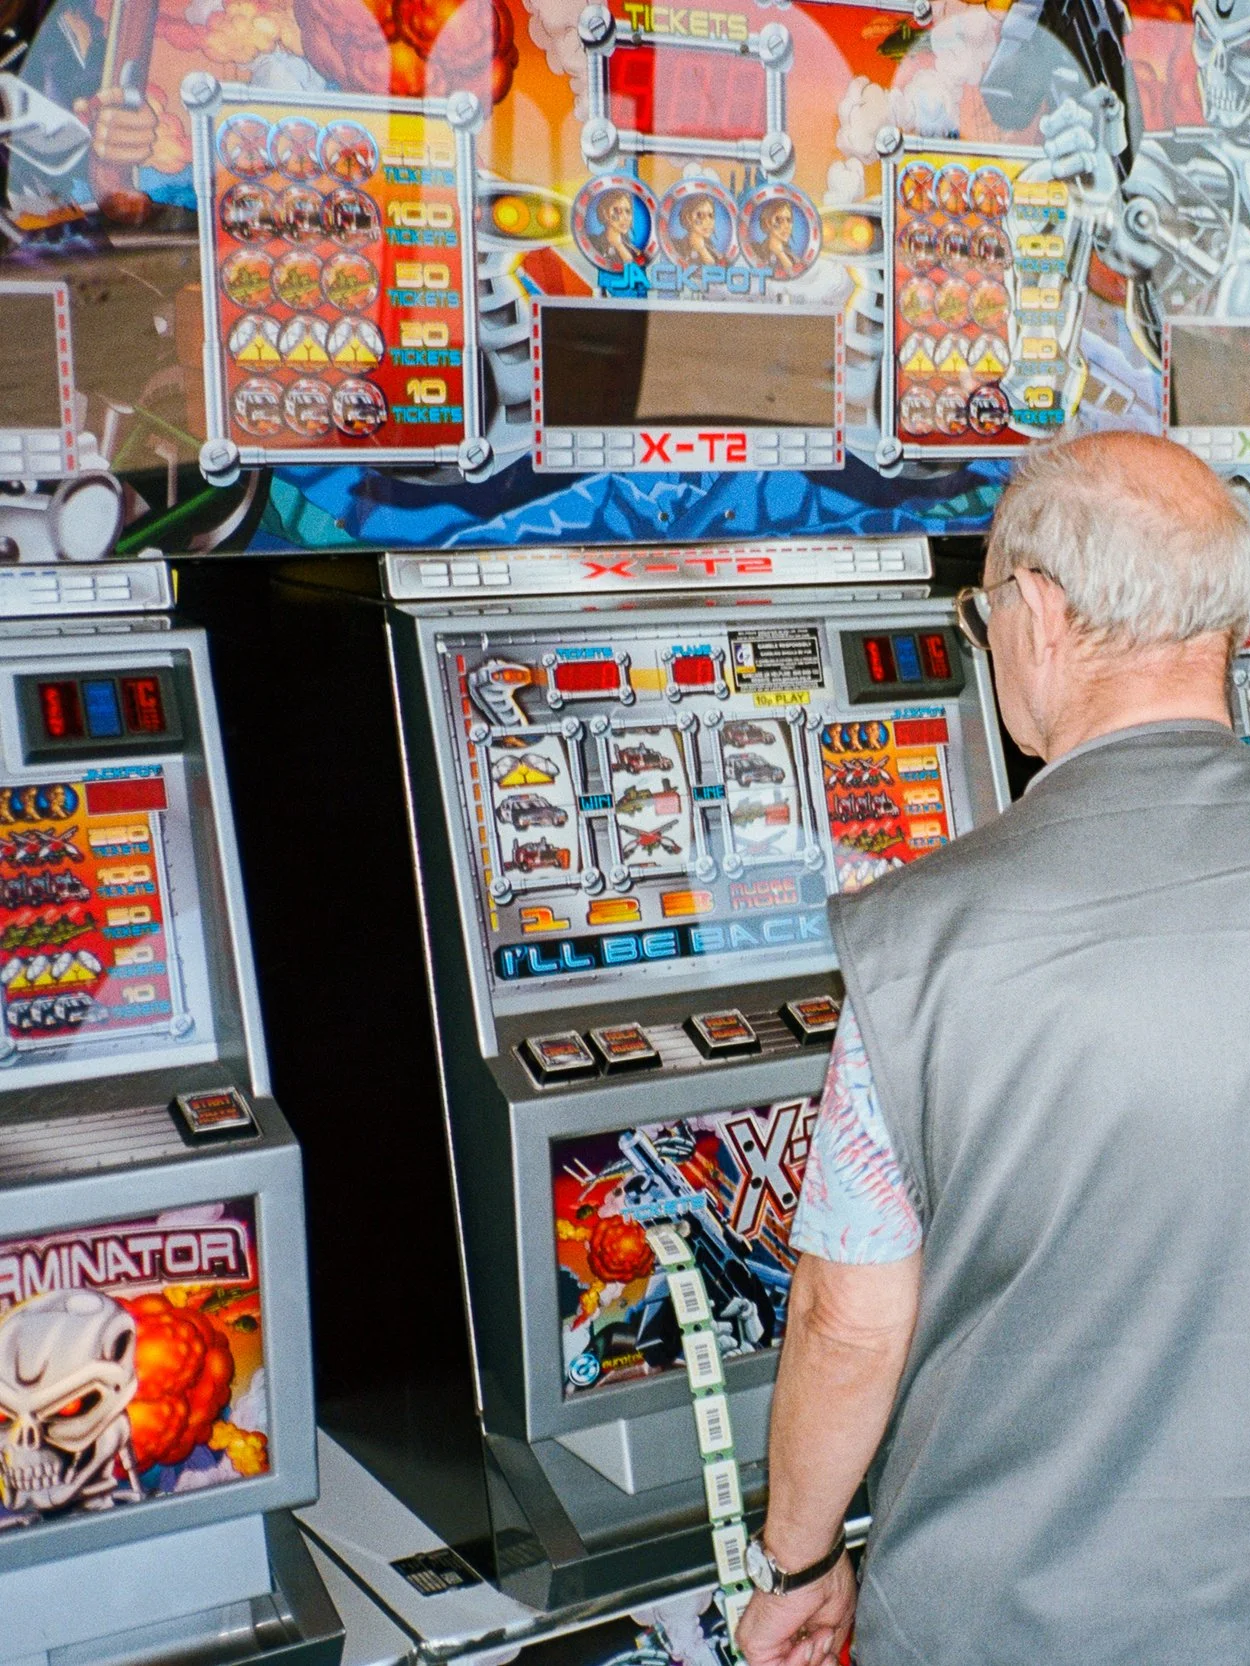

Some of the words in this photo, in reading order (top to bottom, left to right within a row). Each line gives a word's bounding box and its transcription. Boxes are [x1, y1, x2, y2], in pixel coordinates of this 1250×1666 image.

[623, 3, 749, 41] TICKETS
[387, 201, 453, 228] 100
[385, 228, 458, 247] TICKETS
[1017, 233, 1064, 258] 100
[396, 262, 450, 289] 50
[608, 262, 774, 294] JACKPOT
[386, 289, 460, 308] TICKETS
[400, 320, 449, 347] 20
[389, 348, 462, 366] TICKETS
[406, 377, 447, 404] 10
[1024, 386, 1054, 408] 10
[392, 405, 464, 423] TICKETS
[1012, 409, 1065, 424] TICKETS
[639, 432, 747, 464] X-T2
[582, 556, 773, 580] X-T2
[555, 647, 613, 660] TICKETS
[775, 693, 804, 704] PLAY
[82, 764, 162, 781] JACKPOT
[581, 794, 611, 810] WIN
[693, 785, 725, 800] LINE
[97, 864, 152, 885] 100
[730, 878, 796, 898] NUDGE
[587, 897, 641, 926] 2
[661, 889, 714, 918] 3
[731, 892, 797, 910] NOW
[106, 905, 151, 926] 50
[520, 906, 570, 935] 1
[102, 923, 160, 939] TICKETS
[504, 942, 592, 976] I'LL
[602, 927, 678, 963] BE
[691, 914, 827, 953] BACK
[122, 983, 155, 1003] 10
[620, 1195, 706, 1225] TICKETS
